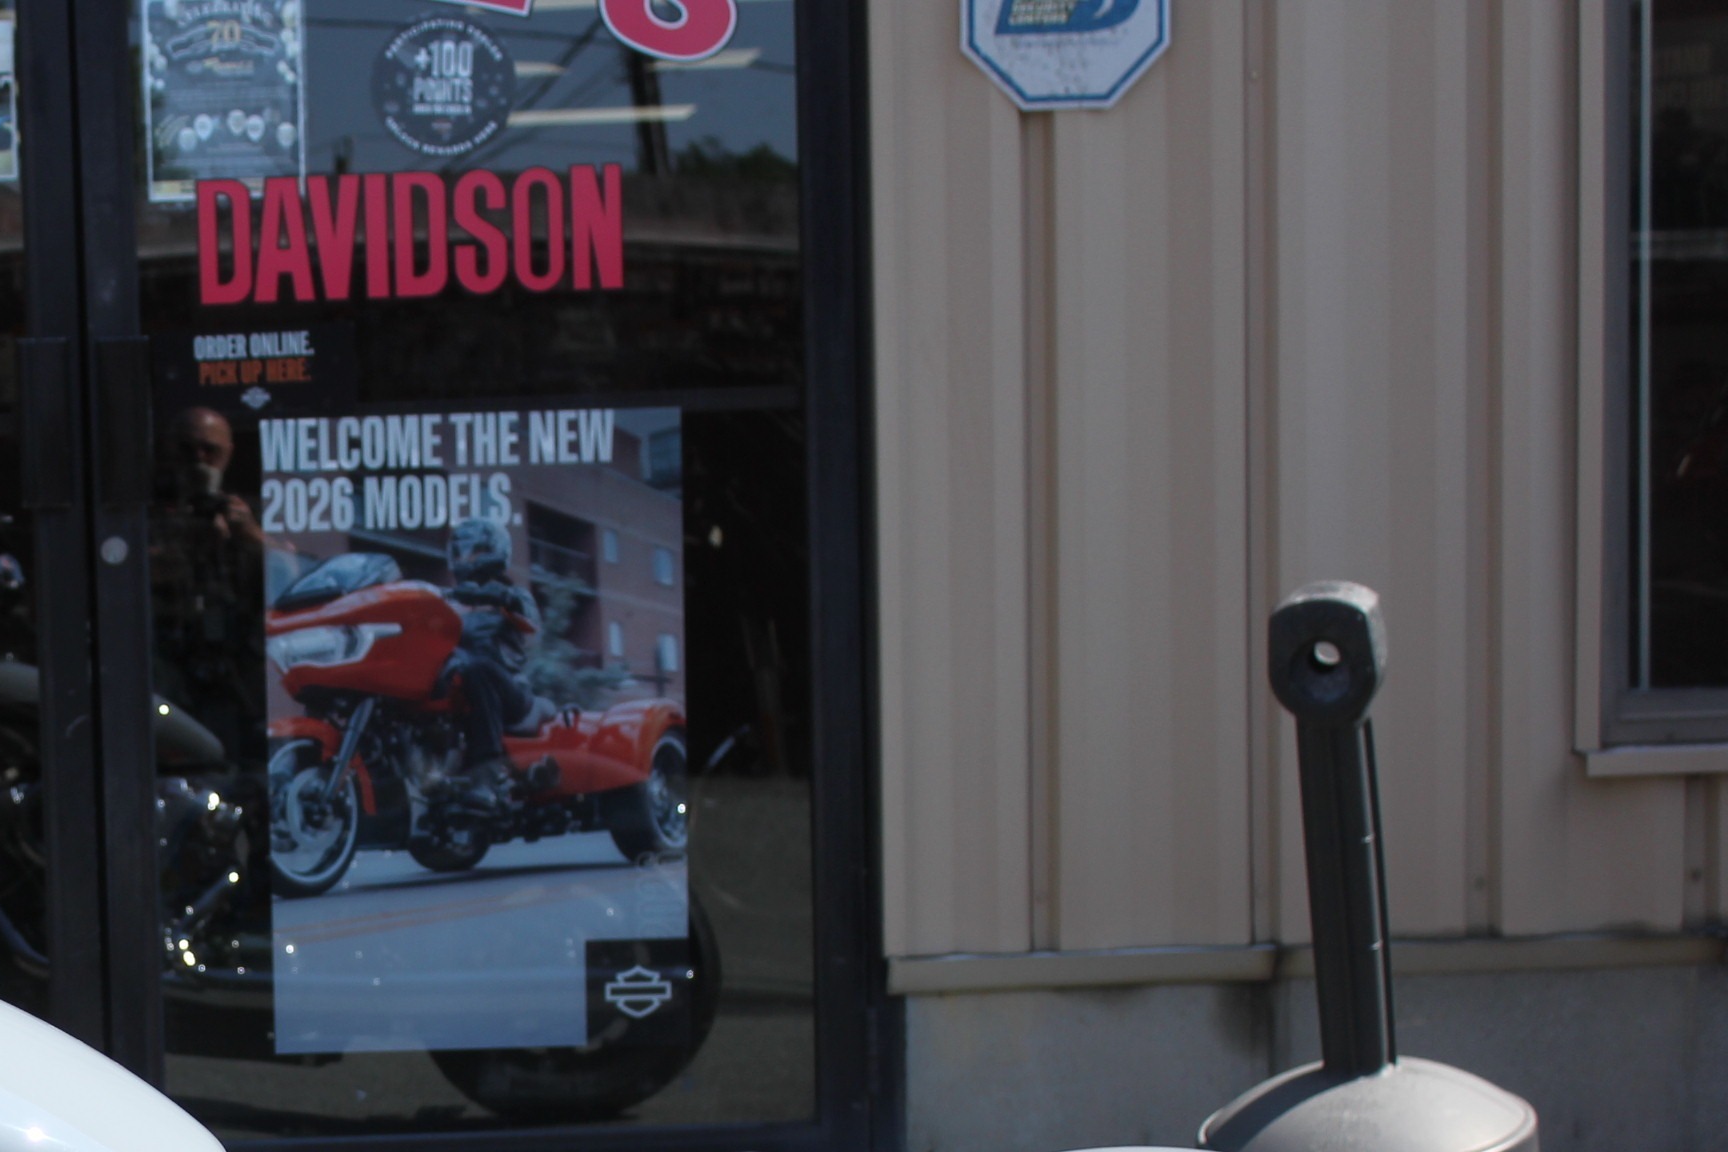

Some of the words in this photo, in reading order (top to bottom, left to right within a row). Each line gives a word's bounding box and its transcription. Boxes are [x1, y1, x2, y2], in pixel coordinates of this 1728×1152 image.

[414, 41, 474, 78] +100
[413, 77, 473, 103] POINTS
[196, 164, 625, 305] DAVIDSON
[193, 333, 247, 360] ORDER
[249, 330, 315, 358] ONLINE.
[198, 360, 238, 385] PICK
[240, 358, 263, 384] UP
[259, 413, 443, 473] WELCOME
[449, 411, 522, 469] THE
[528, 408, 616, 466] NEW
[260, 476, 355, 534] 2026
[362, 472, 523, 531] MODELS.
